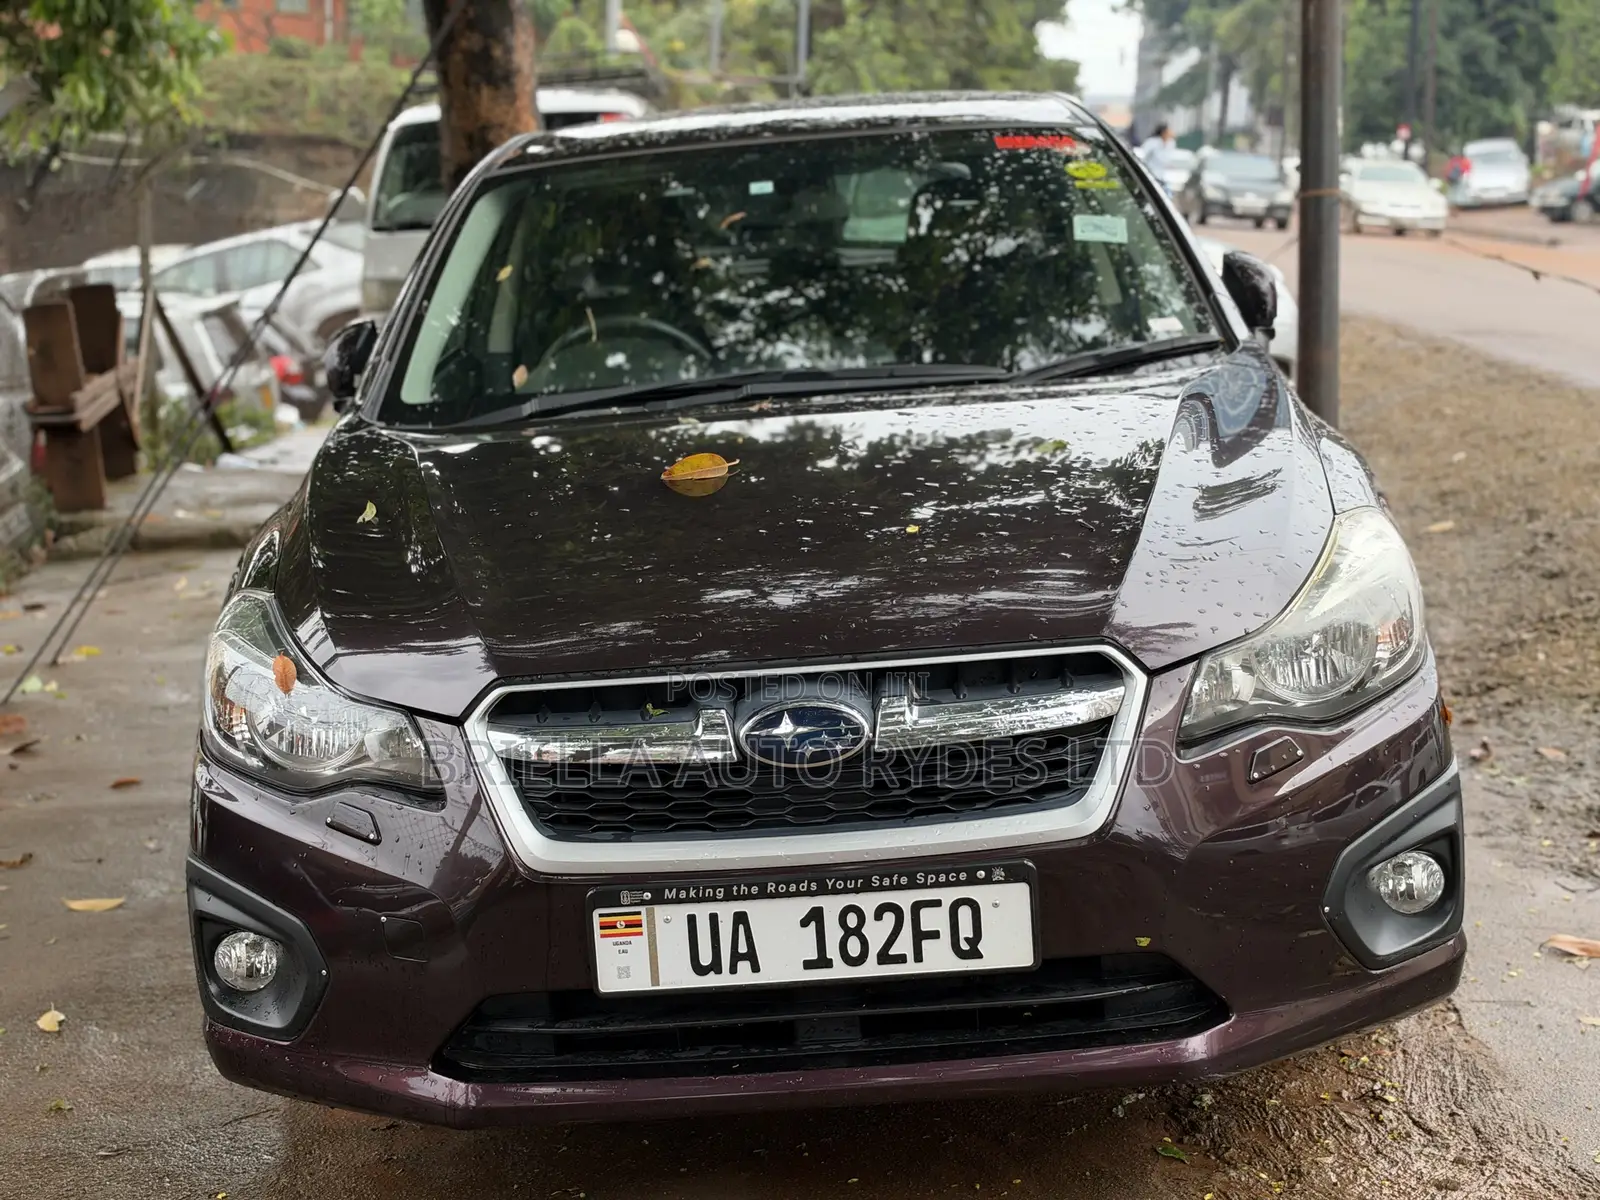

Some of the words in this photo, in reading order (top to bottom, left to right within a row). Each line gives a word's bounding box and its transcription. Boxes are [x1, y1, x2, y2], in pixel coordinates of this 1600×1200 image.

[664, 886, 725, 899] Making
[732, 884, 759, 896] the
[767, 880, 818, 893] Roads
[826, 878, 863, 890] Your
[871, 874, 909, 887] Safe
[916, 872, 968, 886] Space
[686, 910, 761, 976] UA
[799, 897, 984, 970] 182FQ
